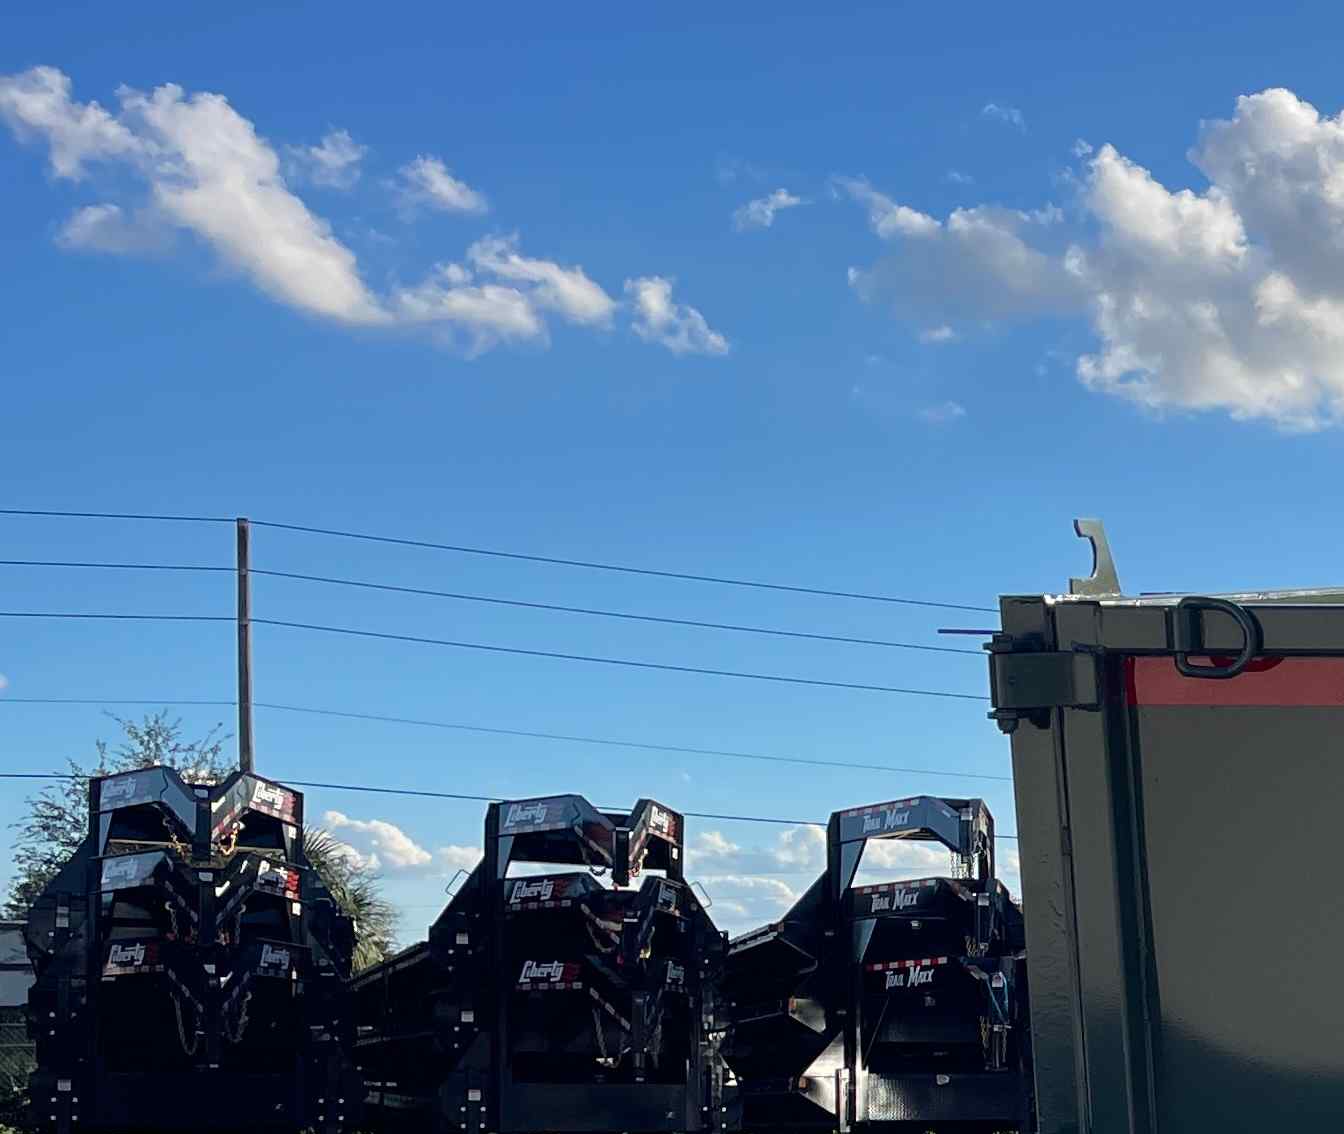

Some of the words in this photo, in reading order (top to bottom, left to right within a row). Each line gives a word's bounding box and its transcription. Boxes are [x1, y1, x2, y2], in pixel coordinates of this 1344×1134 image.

[504, 803, 547, 828] Liberty
[509, 879, 554, 904] Liberty
[108, 942, 146, 969] Liberty
[519, 960, 564, 983] Liberty
